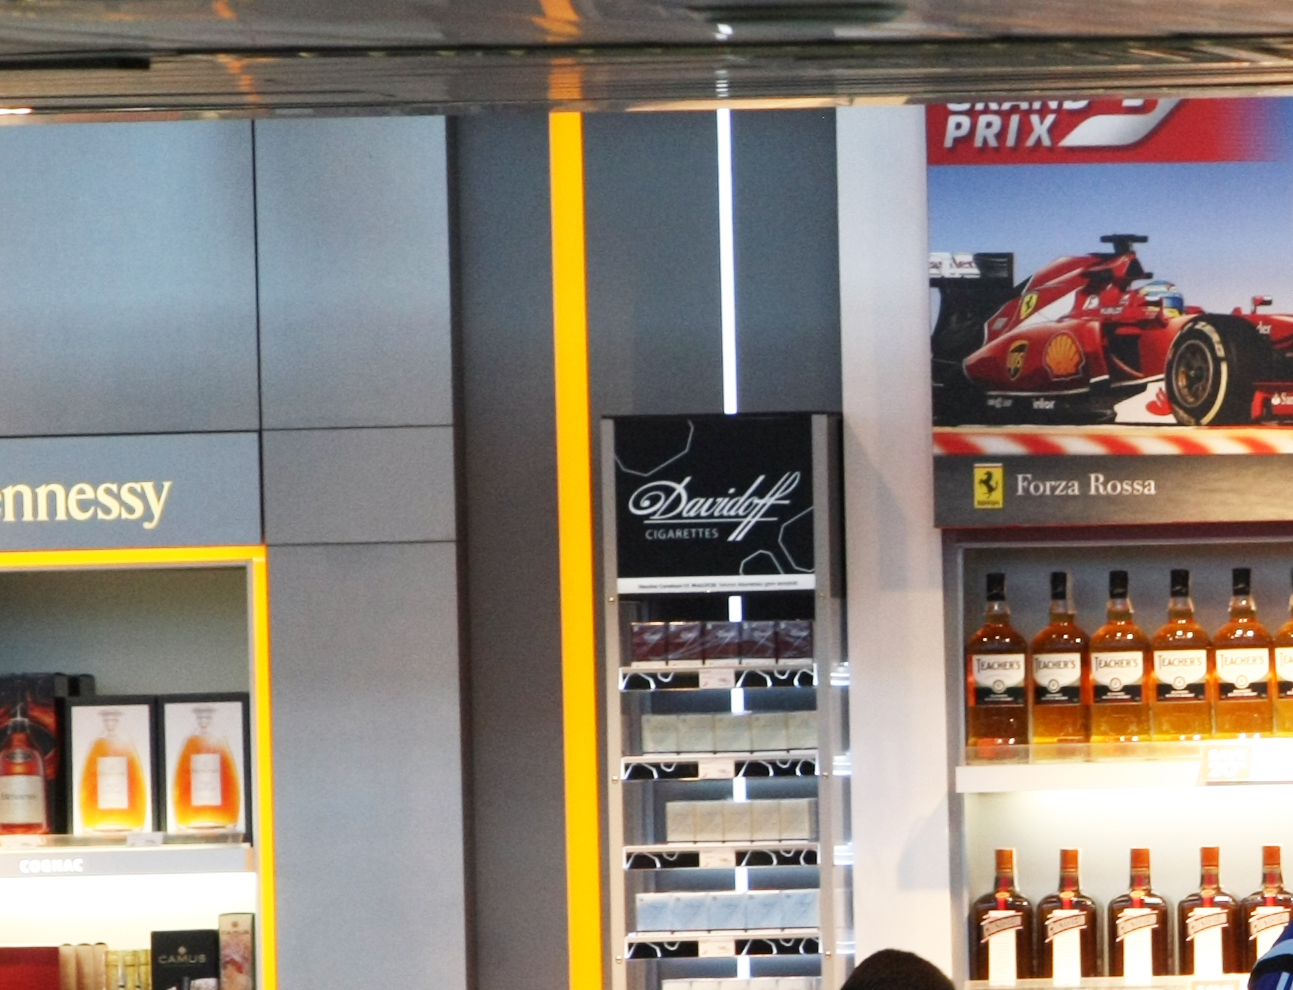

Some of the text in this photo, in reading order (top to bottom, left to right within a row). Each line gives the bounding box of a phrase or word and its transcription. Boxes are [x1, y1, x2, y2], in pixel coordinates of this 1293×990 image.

[943, 114, 1057, 148] PRIX
[1015, 473, 1157, 496] Forza Rossa
[0, 481, 172, 529] nnessy
[628, 470, 800, 542] Davidoff
[645, 528, 719, 541] CIGARETTES
[976, 658, 1021, 672] TEACHER'S
[1034, 657, 1077, 671] TEACHER'S
[19, 858, 84, 873] COGNAC
[158, 954, 206, 964] CAMUS
